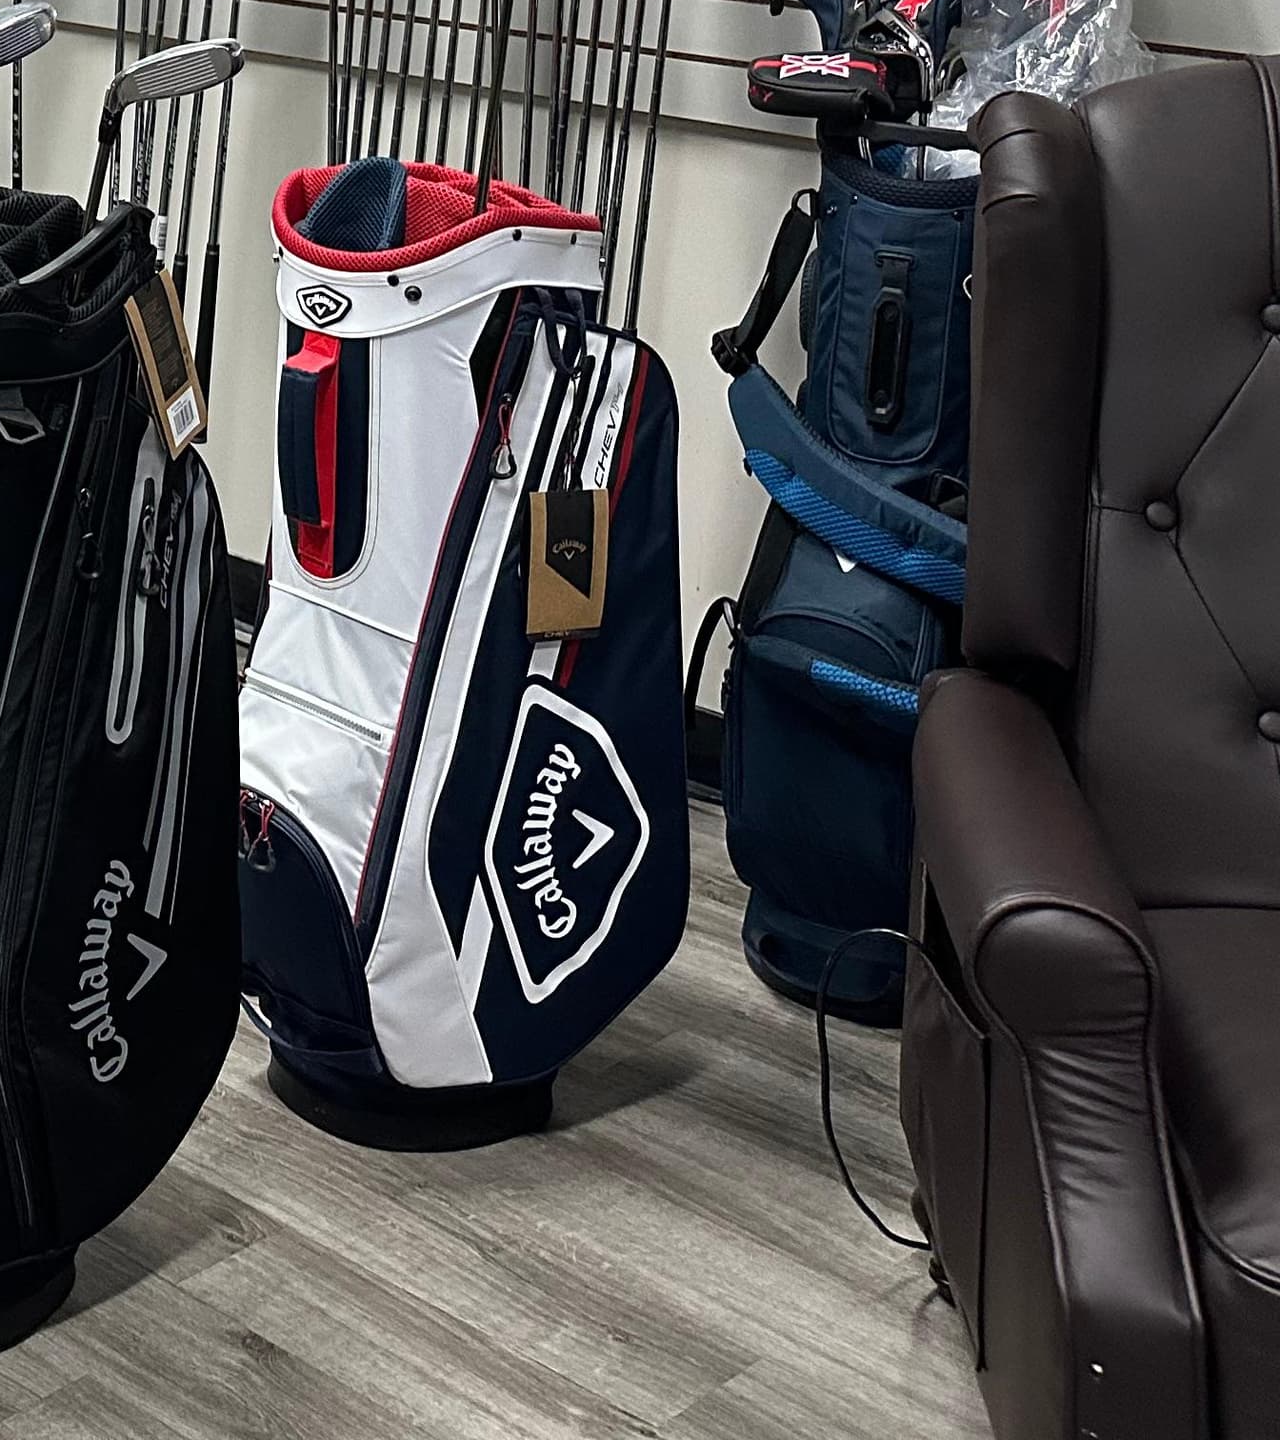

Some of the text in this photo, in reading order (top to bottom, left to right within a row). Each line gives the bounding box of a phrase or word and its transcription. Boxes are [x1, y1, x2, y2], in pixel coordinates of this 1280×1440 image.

[552, 537, 588, 554] Callaway
[513, 743, 582, 939] Callaway
[68, 860, 136, 1083] Callaway
